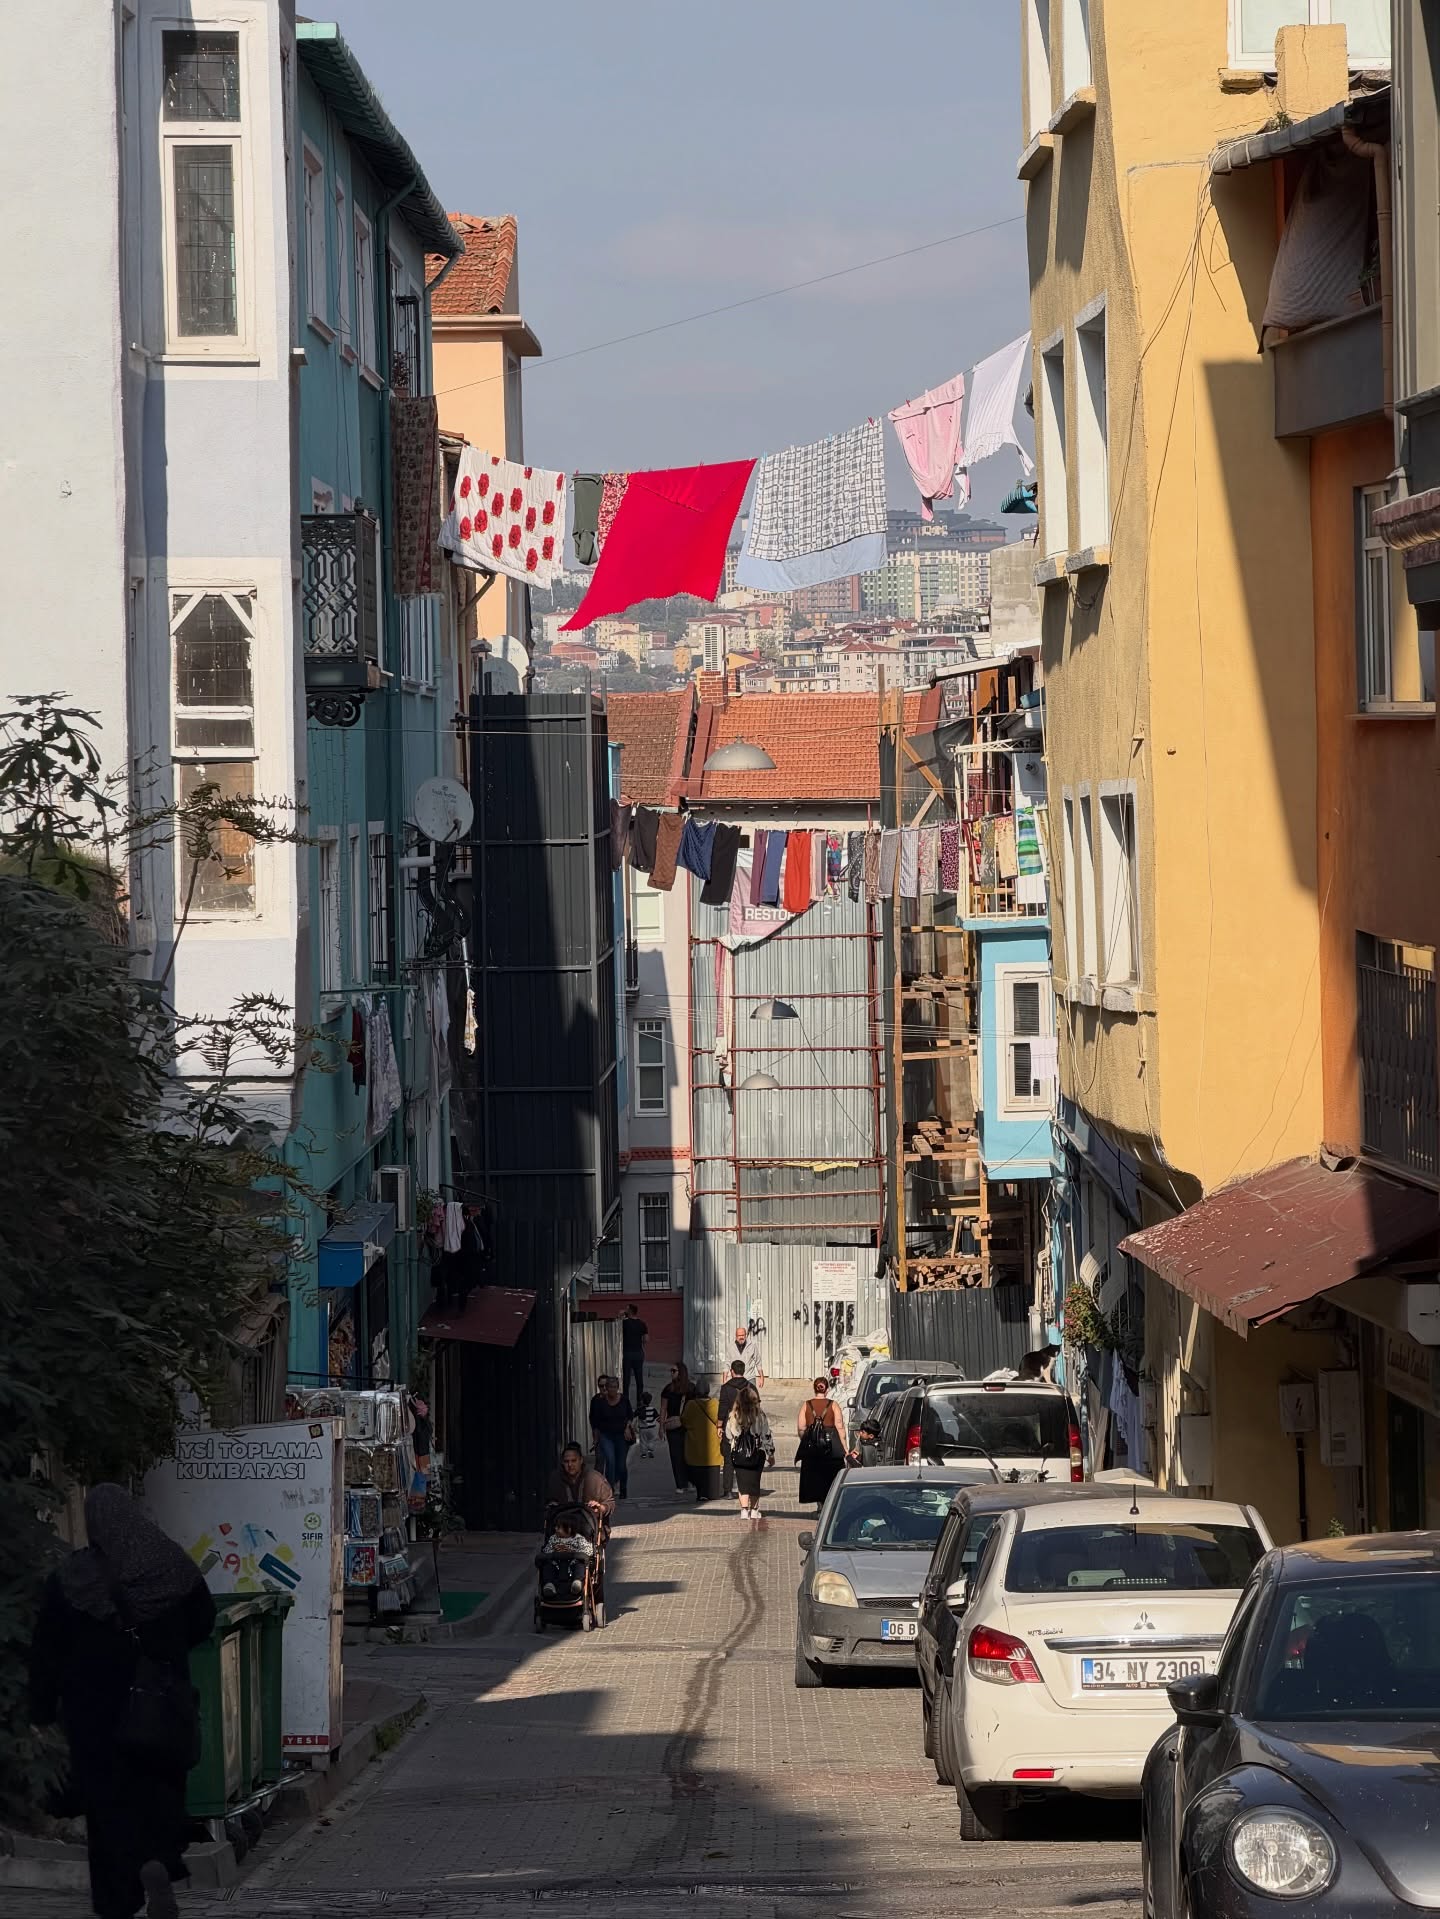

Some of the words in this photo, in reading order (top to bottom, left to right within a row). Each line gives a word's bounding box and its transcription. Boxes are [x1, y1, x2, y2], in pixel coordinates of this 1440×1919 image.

[218, 1441, 323, 1460] TOPLAMA
[177, 1462, 306, 1480] KUMBARASI
[889, 1623, 904, 1635] 06
[1093, 1662, 1116, 1682] 34
[1127, 1661, 1149, 1682] NY
[1156, 1660, 1201, 1681] 2308
